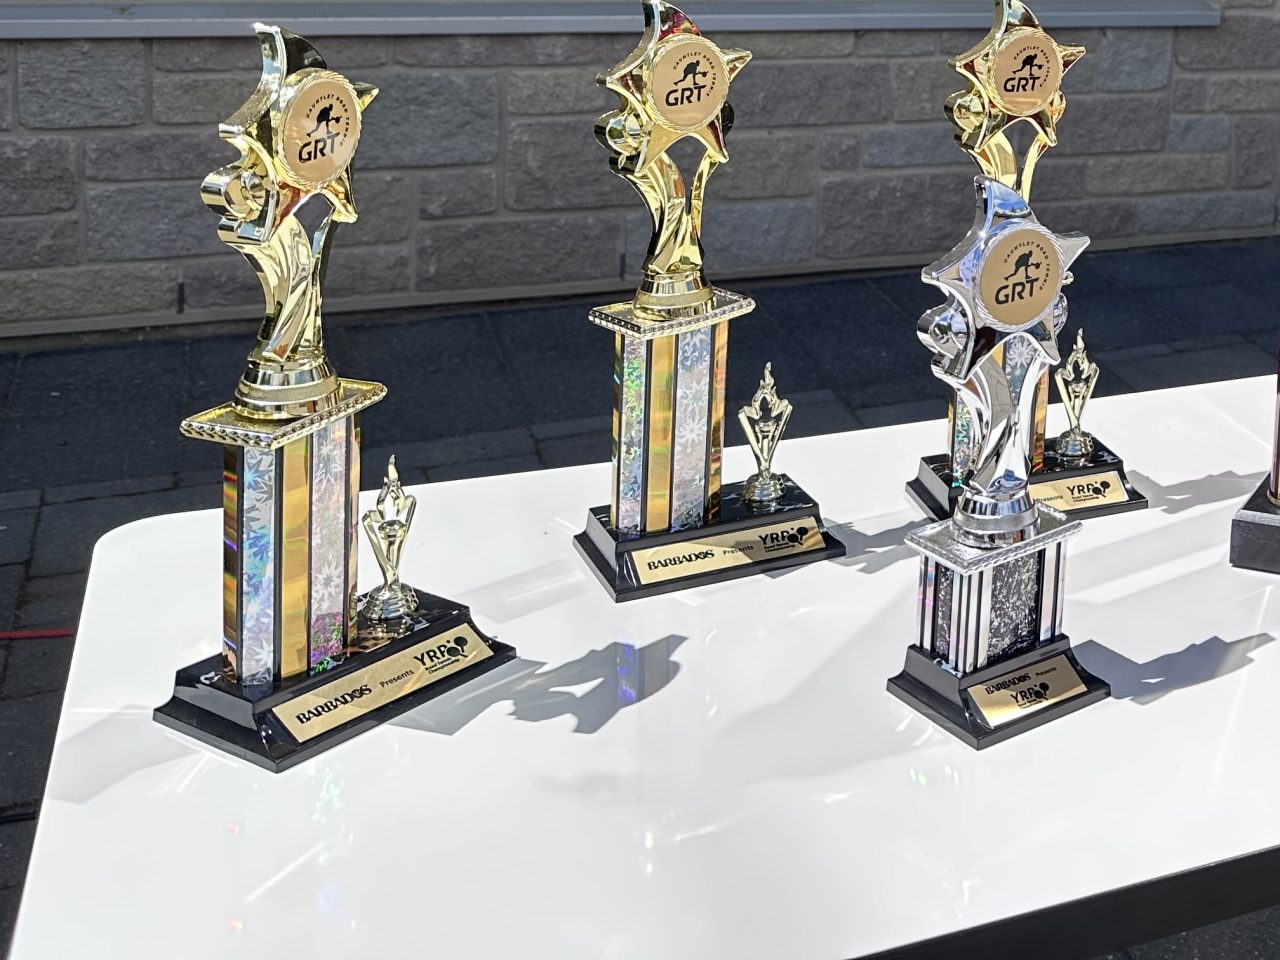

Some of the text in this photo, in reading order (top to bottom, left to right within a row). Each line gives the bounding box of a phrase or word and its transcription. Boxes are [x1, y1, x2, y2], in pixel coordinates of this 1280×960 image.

[665, 84, 707, 107] GRT
[1003, 76, 1041, 93] GRT
[298, 132, 341, 164] GRT
[995, 277, 1040, 305] GRT
[647, 550, 715, 570] BARBADOS
[722, 545, 754, 556] Presents
[295, 683, 373, 724] BARBADOS
[379, 668, 415, 688] Presents
[985, 672, 1031, 695] BARBADOS
